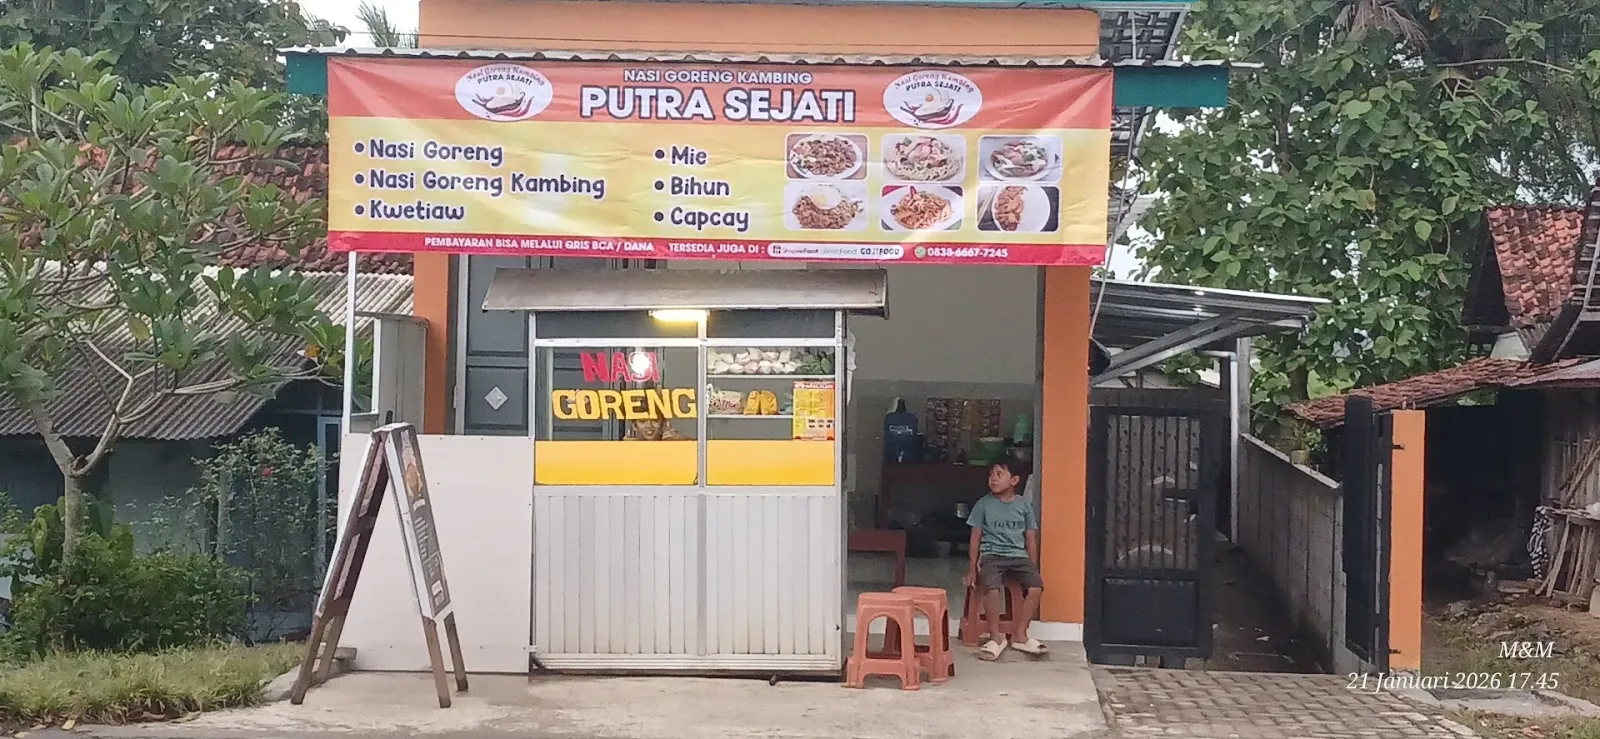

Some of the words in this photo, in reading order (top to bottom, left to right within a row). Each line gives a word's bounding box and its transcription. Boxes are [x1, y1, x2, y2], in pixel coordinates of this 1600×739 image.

[477, 74, 505, 85] PUTRA
[505, 74, 533, 86] SEJATI
[624, 69, 660, 82] NASI
[664, 70, 733, 83] GORENG
[737, 71, 812, 84] KAMBING
[905, 81, 933, 92] PUTRA
[934, 81, 962, 93] SEJATI
[580, 85, 716, 120] PUTRA
[723, 88, 856, 122] SEJATI
[369, 139, 414, 160] Nasi
[423, 141, 503, 167] Goreng
[670, 146, 708, 165] Mie
[369, 170, 414, 190] Nasi
[423, 171, 502, 197] Goreng
[511, 173, 605, 199] Kambing
[670, 176, 730, 196] Bihun
[369, 200, 465, 220] Kwetiaw
[670, 207, 749, 232] Capcay
[424, 237, 493, 247] PEMBAYARAN
[495, 238, 518, 248] BISA
[520, 239, 563, 249] MELALUI
[565, 241, 590, 250] QRIS
[592, 241, 614, 251] BCA
[624, 242, 654, 252] DANA
[669, 243, 715, 253] TERSEDIA
[717, 244, 746, 254] JUGA
[749, 244, 759, 254] DI
[927, 247, 1008, 257] 0838-6667-7245
[552, 388, 697, 420] GORENG
